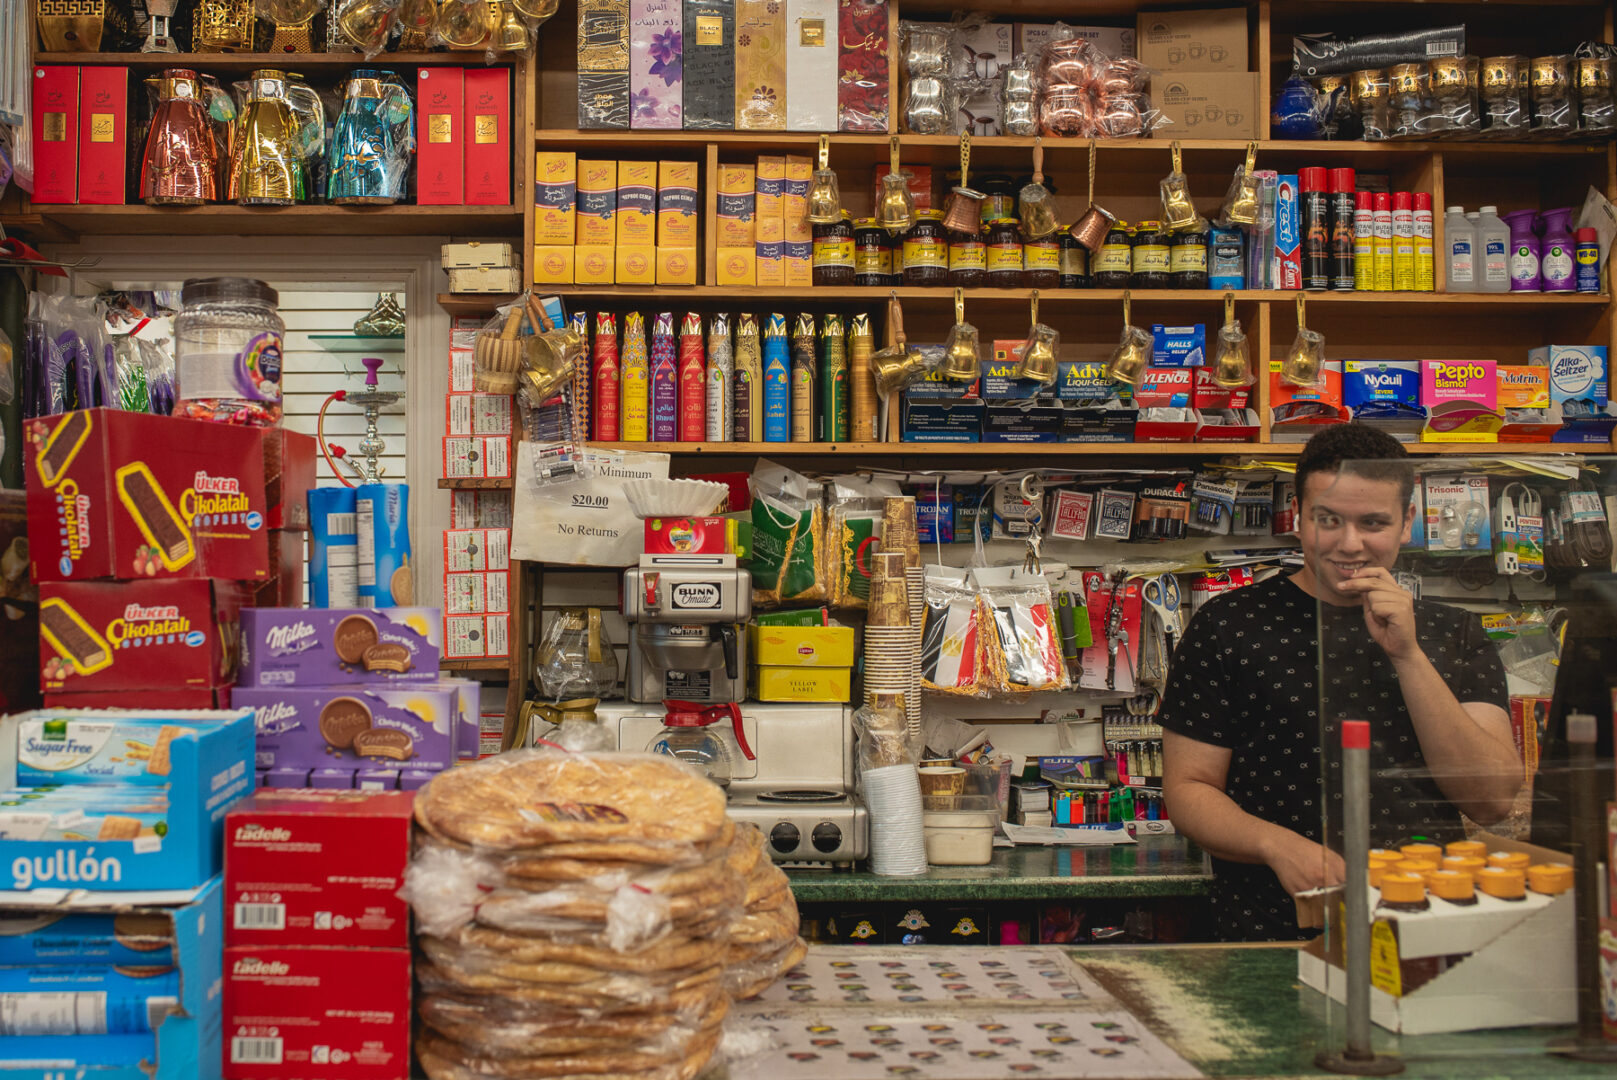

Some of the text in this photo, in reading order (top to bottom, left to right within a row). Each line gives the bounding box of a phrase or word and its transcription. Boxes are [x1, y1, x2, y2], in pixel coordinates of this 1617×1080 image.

[1278, 181, 1293, 242] Crest
[1557, 358, 1582, 368] Alka-
[987, 366, 1017, 377] Advi
[1066, 364, 1108, 378] Advi
[1435, 362, 1485, 381] Pepto
[1554, 364, 1588, 377] Seltzer
[1143, 373, 1190, 384] YLENOL
[1364, 375, 1402, 387] NyQuil
[1435, 379, 1467, 388] Bismol
[1502, 373, 1538, 384] Motrin
[600, 466, 652, 479] Minimum
[196, 471, 238, 494] ÜLKER
[1196, 482, 1234, 495] Panasonic
[1144, 488, 1187, 498] DURACELL
[180, 488, 249, 527] Çikolatalı
[572, 495, 608, 507] $20.00
[558, 524, 618, 537] No Returns
[124, 604, 178, 621] ÜLKER
[106, 617, 190, 650] Çikolatalı
[266, 621, 316, 648] Milka
[255, 702, 298, 728] Milka
[235, 827, 291, 842] tadelle
[12, 847, 122, 889] gullón
[233, 960, 289, 975] tadelle
